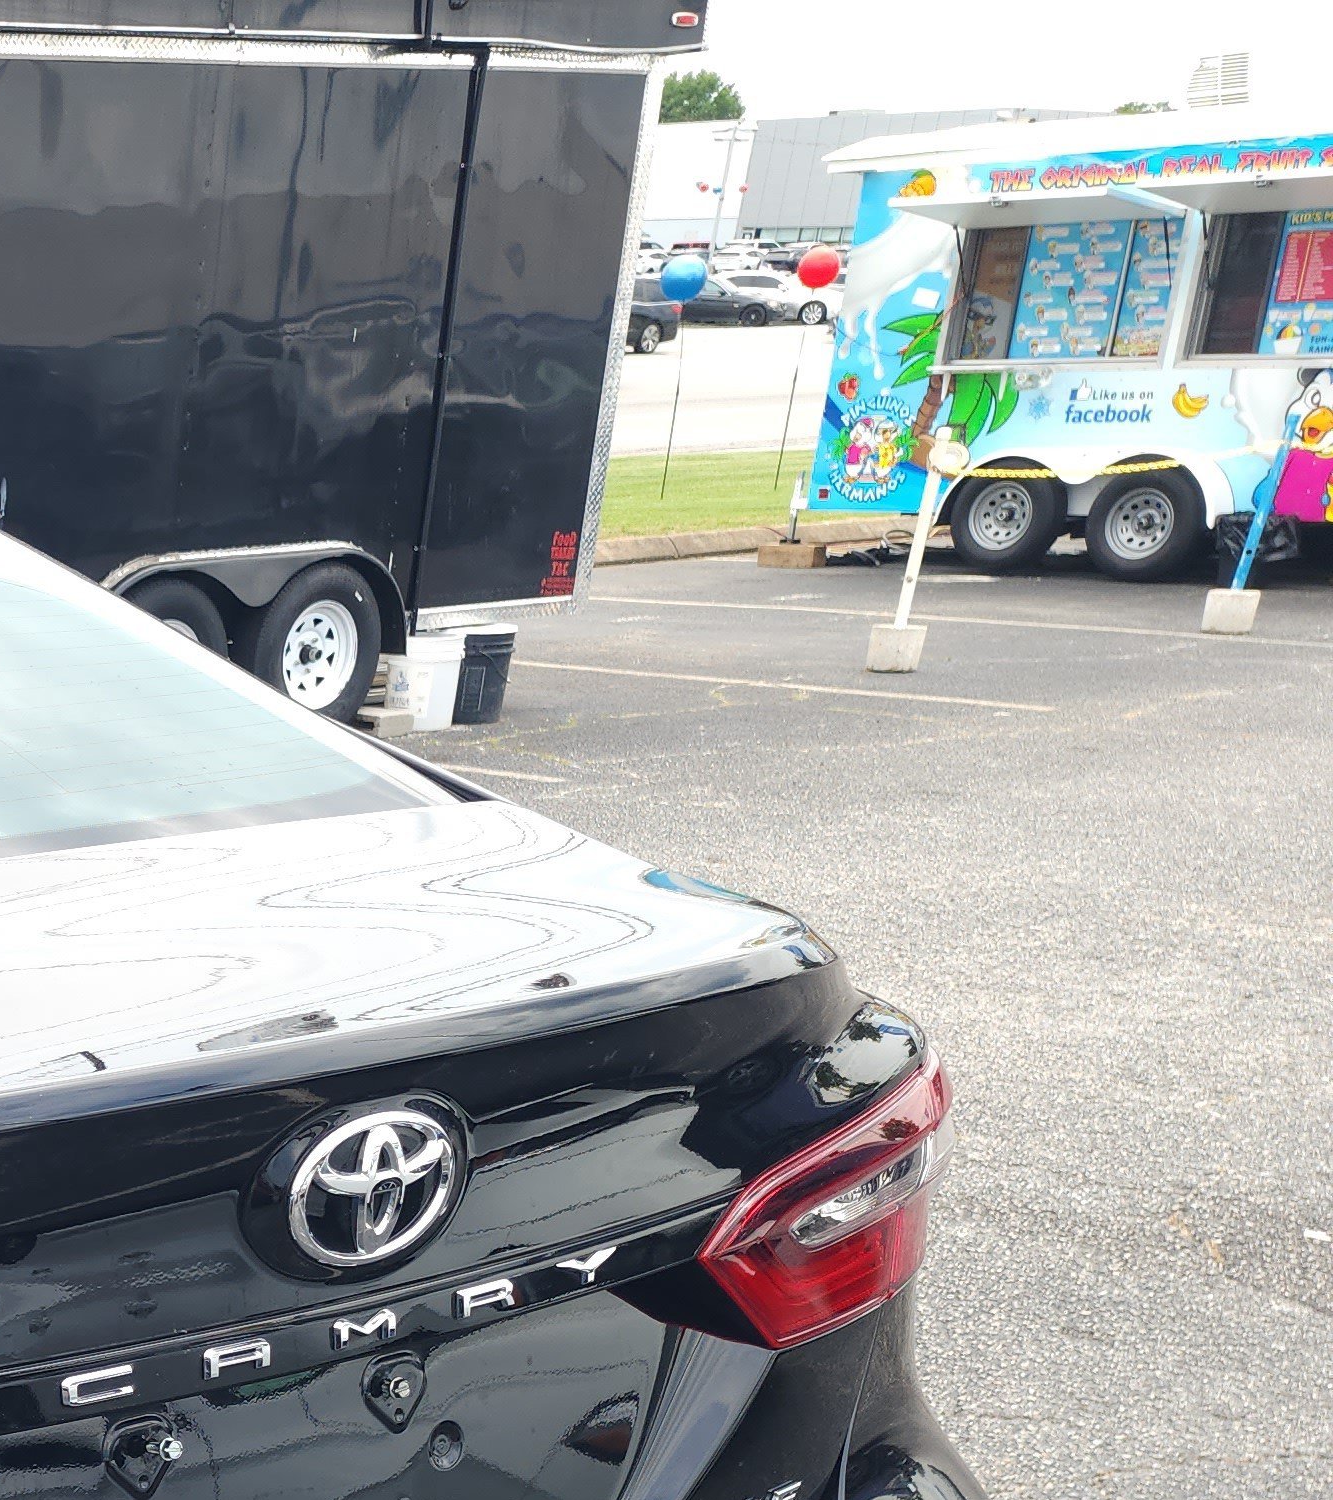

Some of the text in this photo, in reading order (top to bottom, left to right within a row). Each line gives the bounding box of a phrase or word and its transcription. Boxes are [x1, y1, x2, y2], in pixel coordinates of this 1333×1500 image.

[990, 168, 1035, 193] THE
[1040, 158, 1154, 190] ORIGINAL
[1160, 153, 1229, 178] REAL
[1235, 147, 1314, 171] FRUIT
[840, 394, 916, 428] PINGUINOS
[1093, 389, 1154, 400] Like us on
[1064, 403, 1152, 424] facebook
[828, 468, 907, 502] HERMANOS
[60, 1247, 617, 1407] CAMRY
